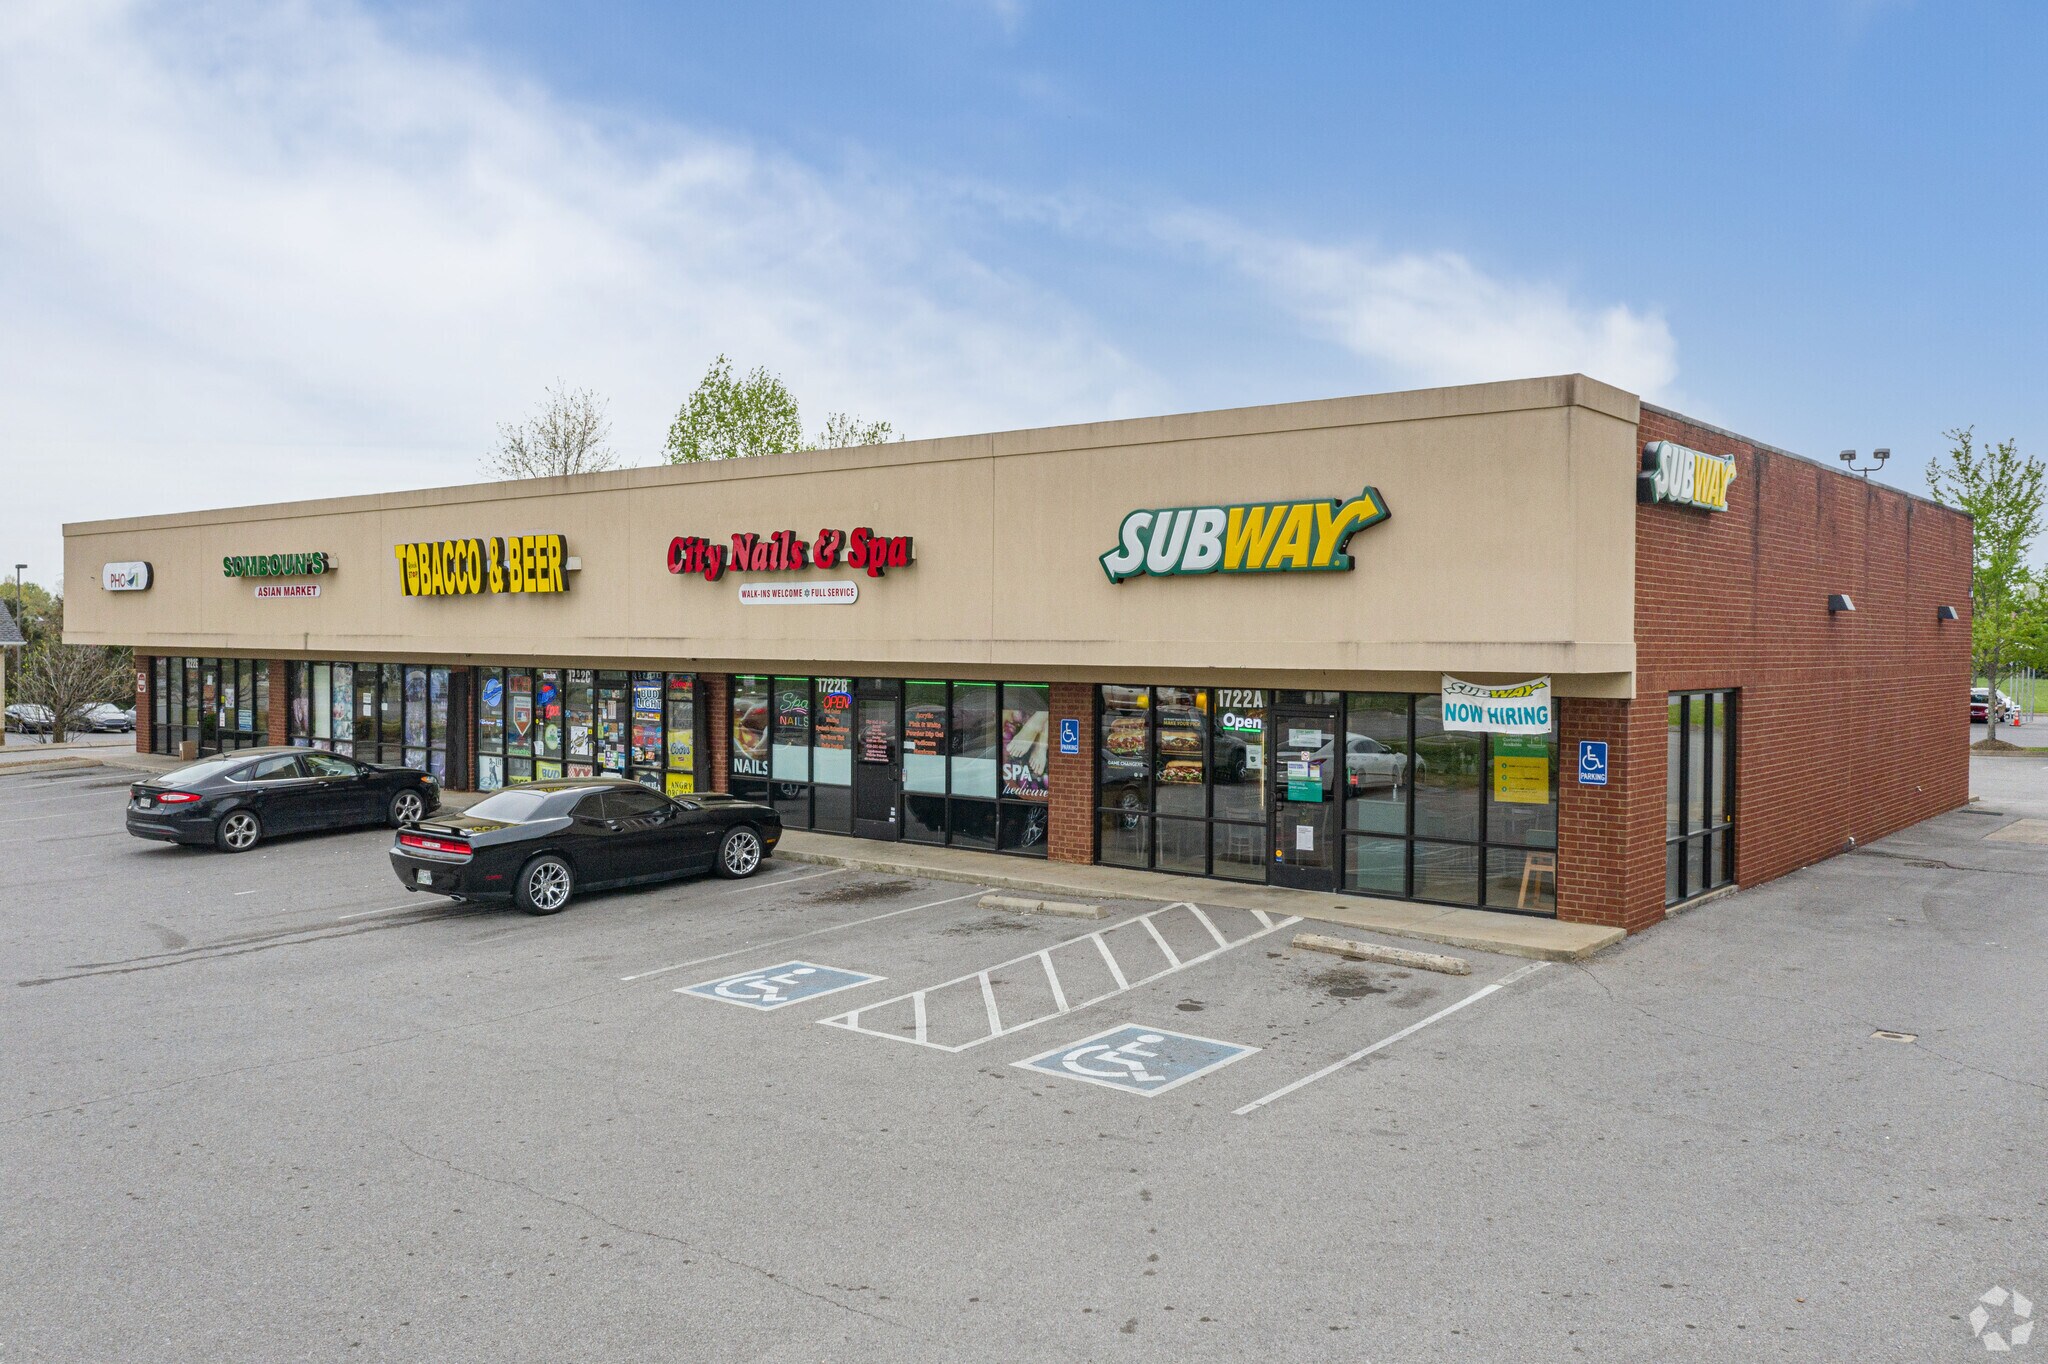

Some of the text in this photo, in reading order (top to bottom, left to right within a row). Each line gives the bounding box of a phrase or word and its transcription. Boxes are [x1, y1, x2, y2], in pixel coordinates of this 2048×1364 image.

[1654, 443, 1737, 508] SUBWAY
[1102, 493, 1379, 578] SUBWAY
[667, 527, 908, 581] City Nails & Spa
[222, 552, 325, 578] SOMBOUN'S
[394, 534, 564, 597] TOBACCO & BEER
[110, 573, 126, 588] PHO
[258, 586, 317, 597] ASIAN MARKET
[741, 587, 854, 598] WALK-INS WELCOME FULL SERVICE
[640, 689, 659, 698] BUD
[818, 678, 848, 693] 1722B
[1443, 680, 1548, 699] SUBWAY
[637, 698, 661, 710] LIGHT
[780, 693, 808, 711] Spa
[823, 695, 850, 709] OPEN
[1218, 689, 1263, 708] 1722A
[779, 715, 809, 727] NAILS
[1223, 712, 1262, 731] Open
[1445, 703, 1548, 726] NOW HIRING
[541, 768, 560, 779] BUD
[734, 758, 768, 775] NAILS
[1003, 763, 1032, 782] SPA
[671, 781, 692, 790] ANGRY
[1580, 772, 1606, 782] PARKING
[1002, 781, 1048, 798] pedicure
